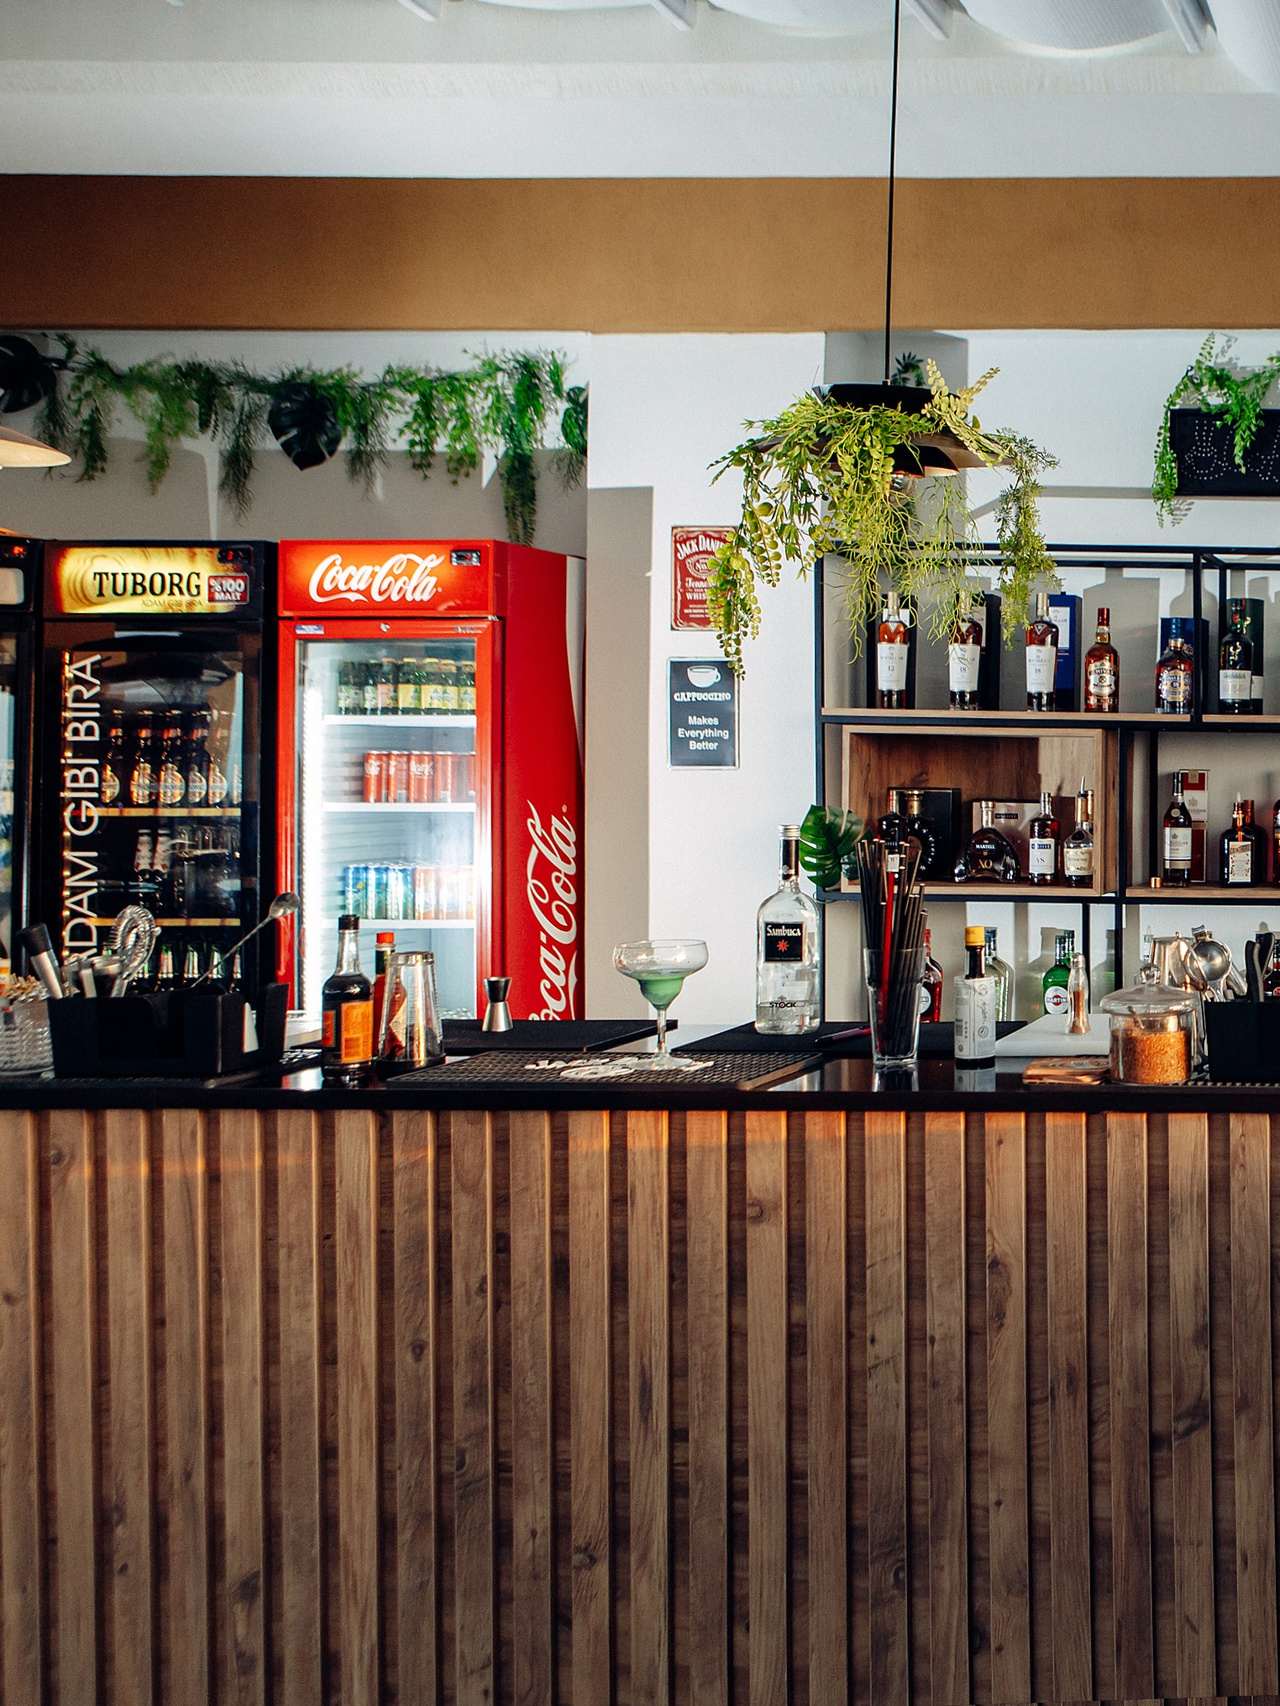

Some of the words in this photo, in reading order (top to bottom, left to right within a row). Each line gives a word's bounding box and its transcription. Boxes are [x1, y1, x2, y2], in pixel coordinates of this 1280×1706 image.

[676, 539, 699, 560] JACK
[698, 534, 725, 553] DANI
[93, 571, 201, 597] TUBORG
[308, 553, 446, 603] Coca-Cola
[209, 578, 245, 592] %100
[214, 591, 242, 601] MALT
[66, 654, 102, 742] BIRA
[673, 691, 732, 702] CAPPUCCINO
[688, 715, 719, 726] Makes
[677, 727, 730, 740] Everything
[689, 740, 719, 750] Better
[978, 859, 993, 869] XO
[766, 924, 802, 936] Sambuca
[768, 1001, 797, 1010] STOCK
